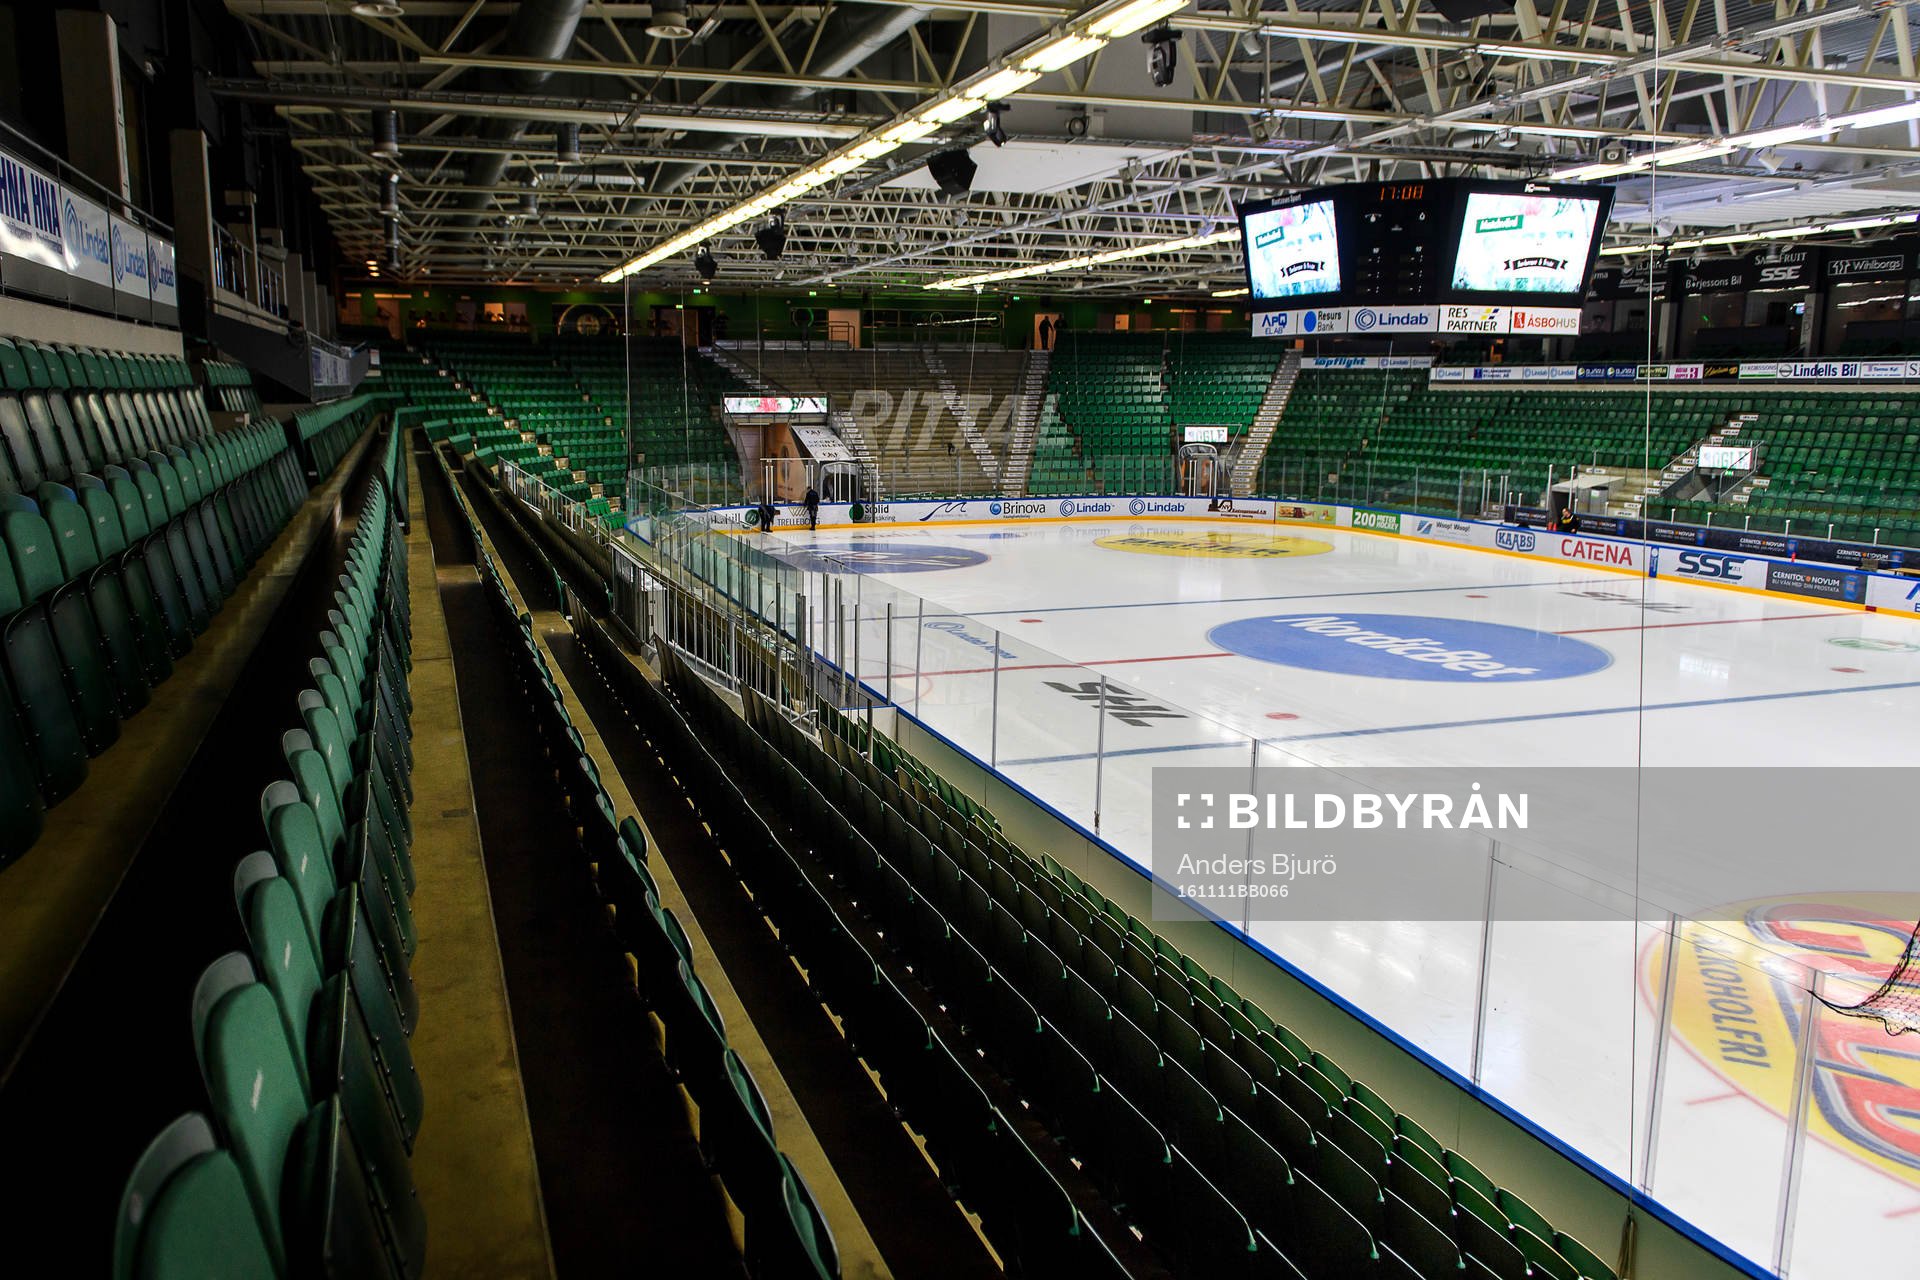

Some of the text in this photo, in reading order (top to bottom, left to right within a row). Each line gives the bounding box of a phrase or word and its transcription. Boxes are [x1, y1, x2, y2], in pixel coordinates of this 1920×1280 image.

[30, 172, 62, 238] HNA
[79, 220, 109, 265] Lindab
[124, 242, 147, 279] Lindab
[1760, 265, 1802, 282] SSE
[1318, 310, 1342, 321] Resurs
[1379, 313, 1429, 326] Lindab
[1448, 307, 1468, 318] RES
[1317, 321, 1334, 332] Bank
[1447, 320, 1498, 332] PARTNER
[1527, 315, 1577, 329] ÅSBOHUS
[1793, 364, 1837, 377] Lindells
[1841, 363, 1858, 377] Bil
[1003, 502, 1046, 514] Brinova
[1076, 503, 1111, 512] Lindab
[1147, 502, 1185, 512] Lindab
[777, 518, 821, 526] TRELLEBOG
[1354, 511, 1376, 528] 200
[1498, 531, 1533, 547] KAABS
[1561, 538, 1632, 566] CATENA
[1675, 552, 1748, 580] SSE
[1772, 571, 1840, 587] CERNITOL NOVUM
[1271, 616, 1541, 678] NordicBet
